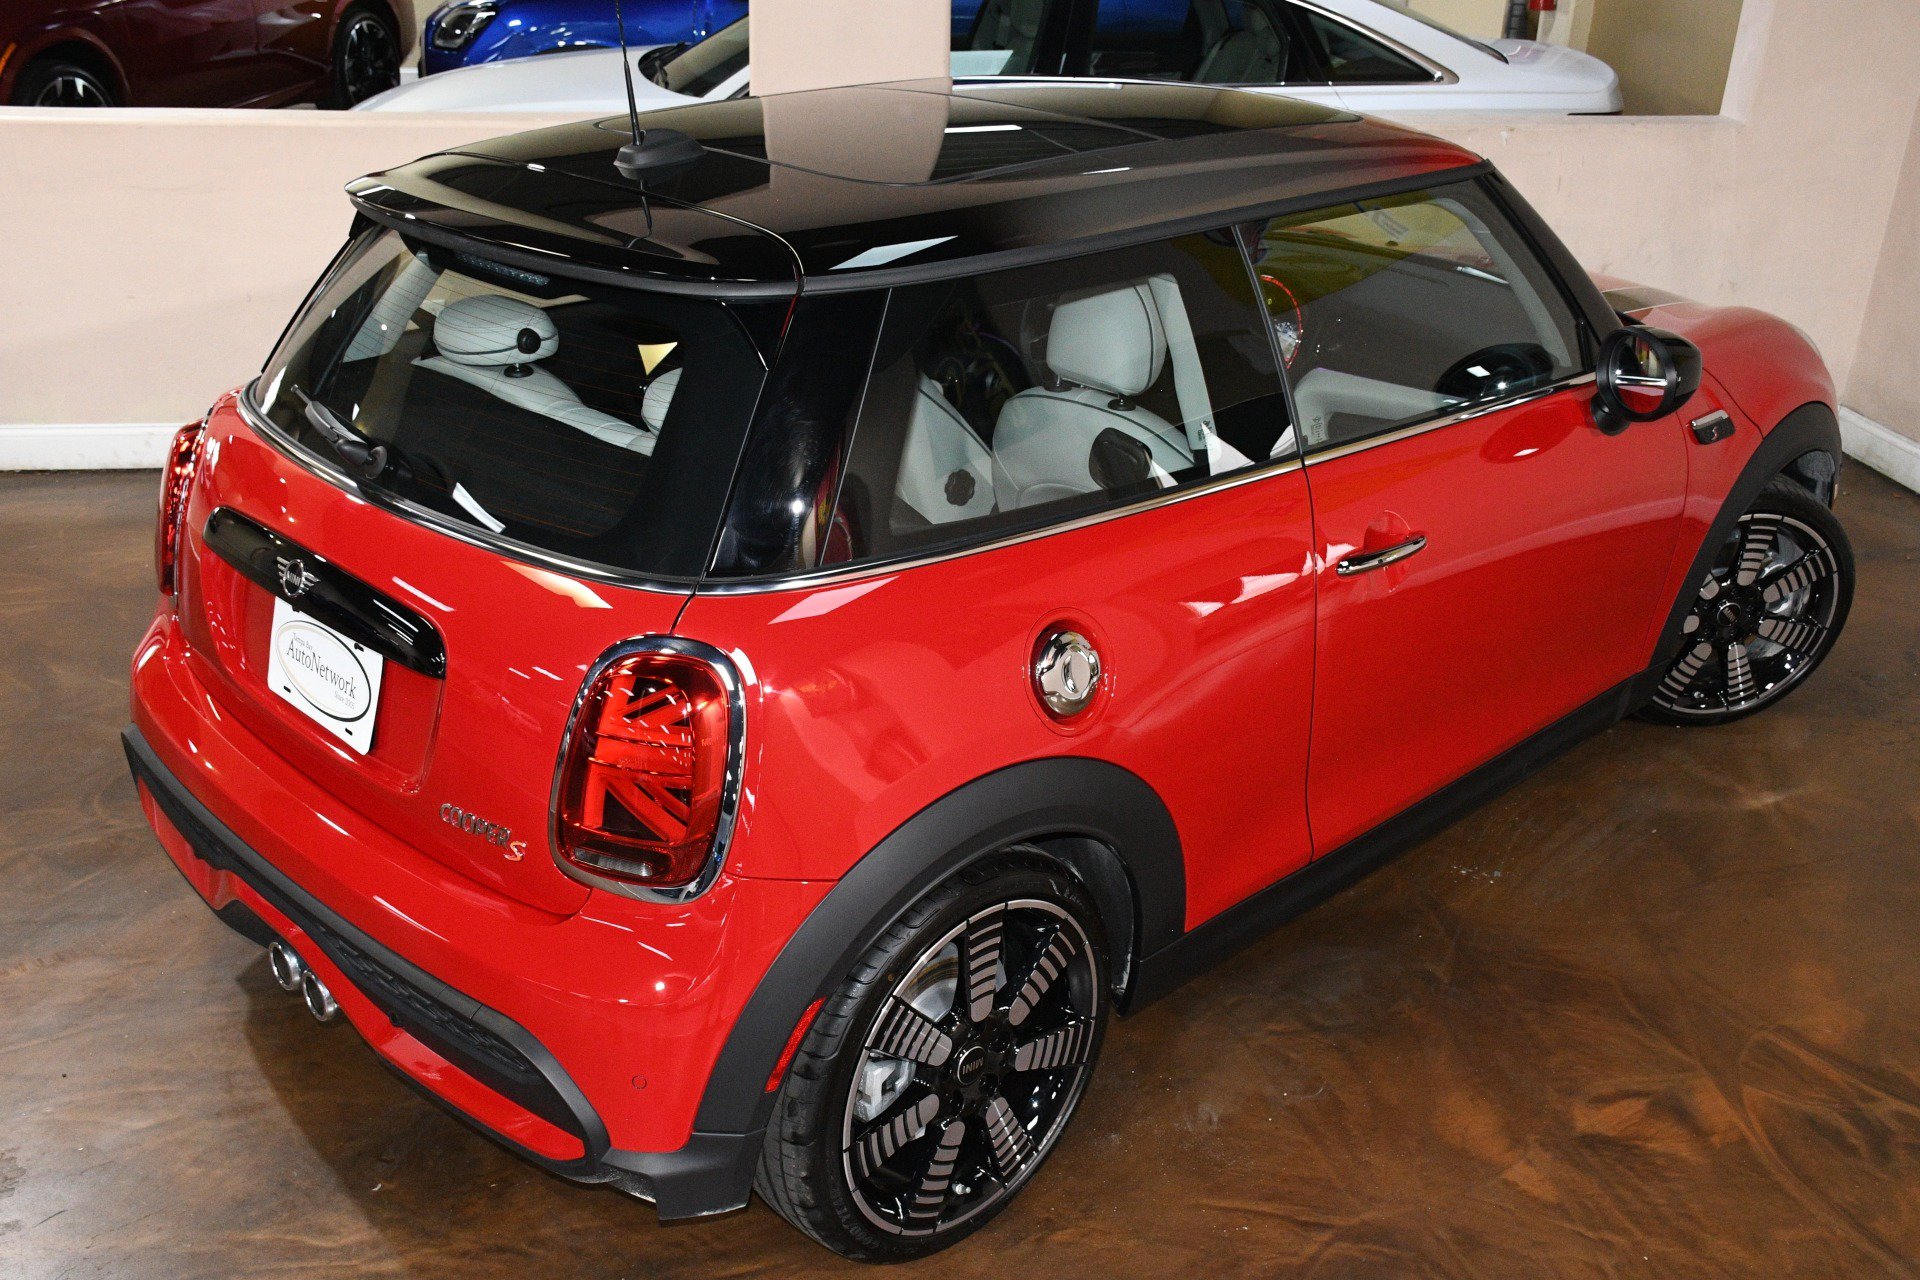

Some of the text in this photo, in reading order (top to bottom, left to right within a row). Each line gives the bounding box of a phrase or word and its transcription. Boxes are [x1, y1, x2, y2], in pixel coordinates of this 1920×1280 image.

[292, 632, 305, 647] Tampa
[286, 639, 357, 699] AutoNetwork
[334, 690, 345, 703] Since
[439, 803, 527, 862] COOPER S
[962, 1057, 984, 1075] MINI
